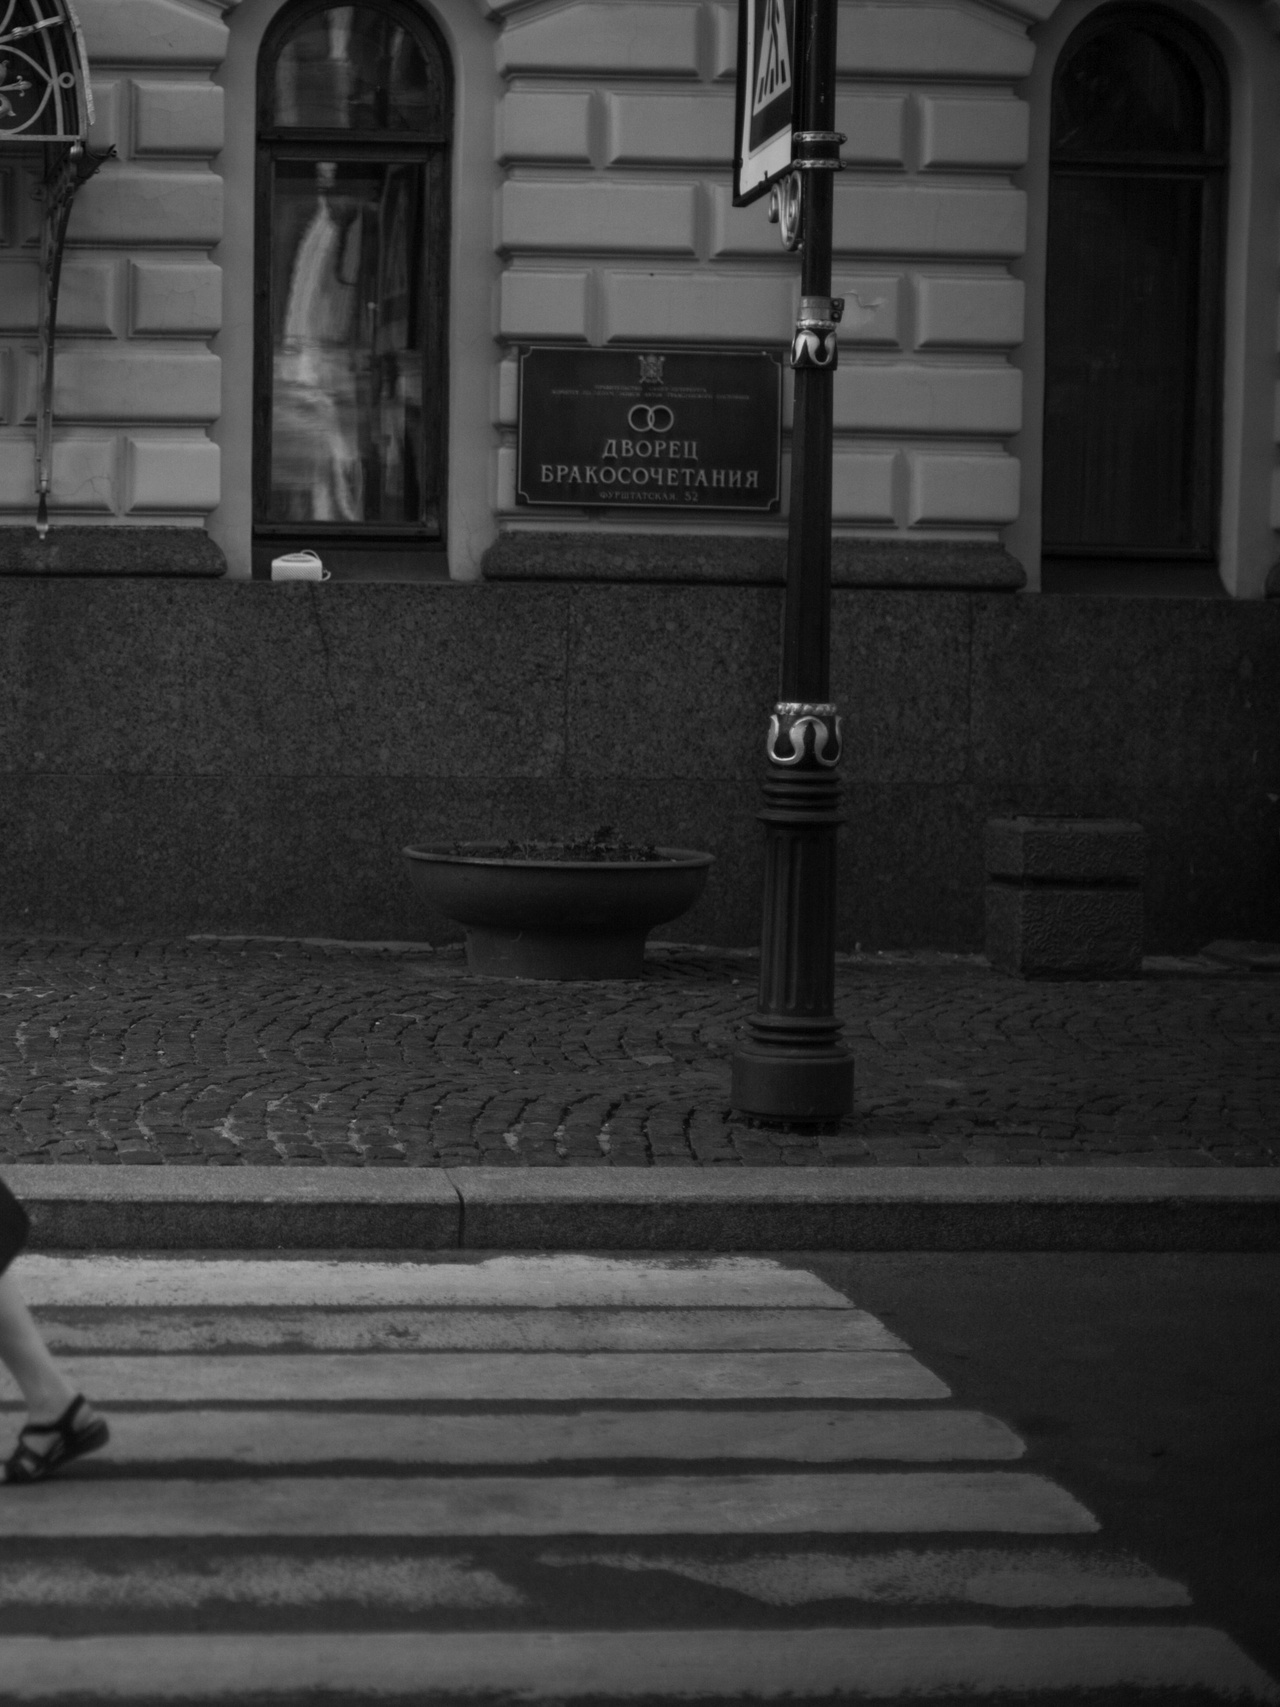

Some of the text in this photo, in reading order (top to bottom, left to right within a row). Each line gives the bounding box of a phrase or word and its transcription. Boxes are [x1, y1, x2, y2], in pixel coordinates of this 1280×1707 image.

[601, 439, 699, 461] ДВОРЕЦ
[540, 464, 759, 488] БРАКОСОЧЕТАНИЯ
[684, 491, 699, 502] 52
